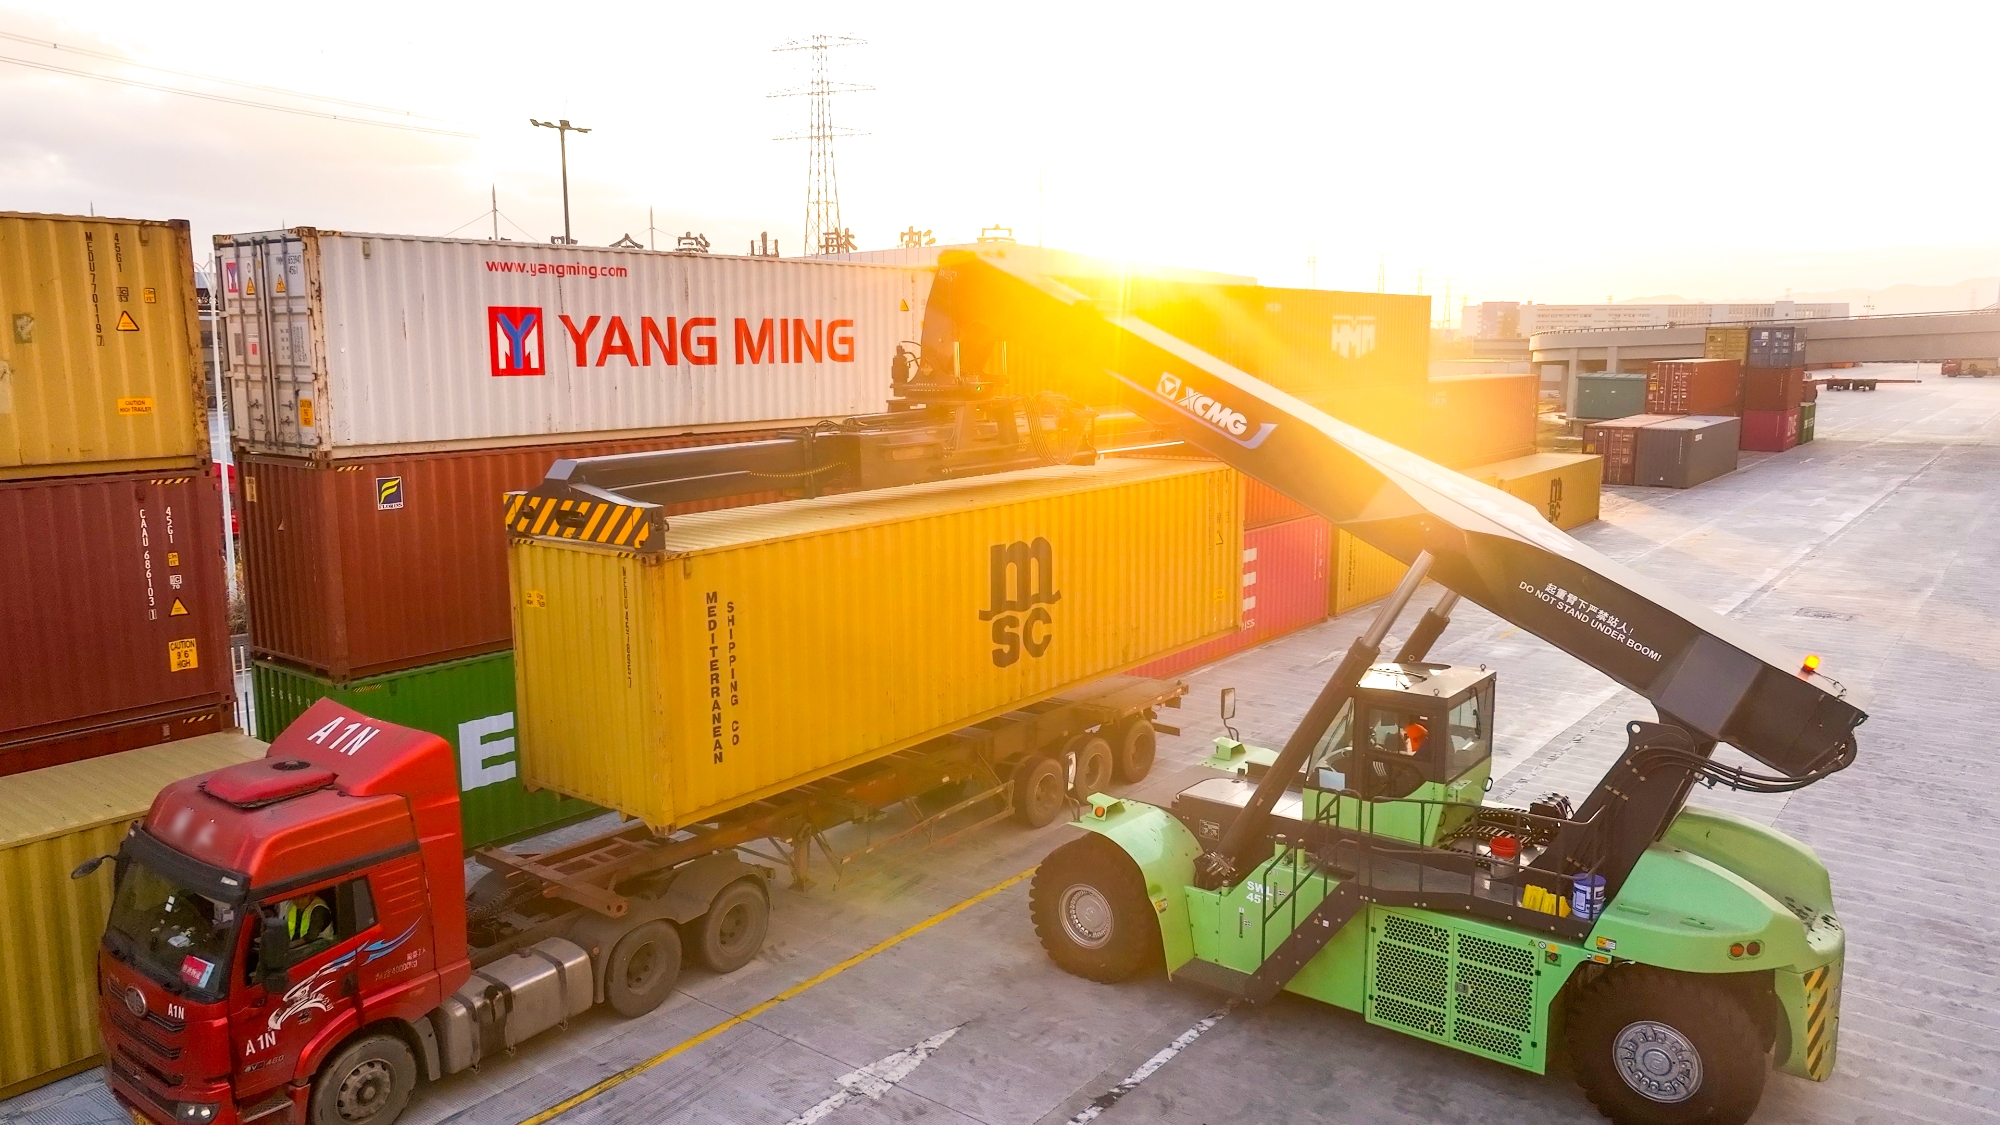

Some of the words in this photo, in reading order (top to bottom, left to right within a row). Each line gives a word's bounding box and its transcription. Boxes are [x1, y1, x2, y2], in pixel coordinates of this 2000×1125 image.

[114, 233, 122, 272] 45G1
[485, 260, 628, 279] www.yangming.com
[557, 314, 718, 368] YANG
[734, 317, 855, 366] MING
[1176, 386, 1248, 436] XCMG
[165, 506, 174, 544] 45G1
[139, 508, 149, 547] CAAU
[144, 550, 155, 606] 686103
[1518, 581, 1535, 594] DO
[1534, 589, 1557, 605] NOT
[1556, 601, 1590, 624] STAND
[1590, 618, 1626, 644] UNDER
[1626, 637, 1663, 662] BOOM!
[170, 640, 195, 651] CAUTION
[176, 660, 191, 669] HIGH
[726, 601, 739, 706] SHIPPING
[706, 591, 724, 764] MEDITERRANEAN
[307, 716, 380, 756] A1N
[731, 720, 740, 746] CO
[168, 1003, 185, 1020] A1N
